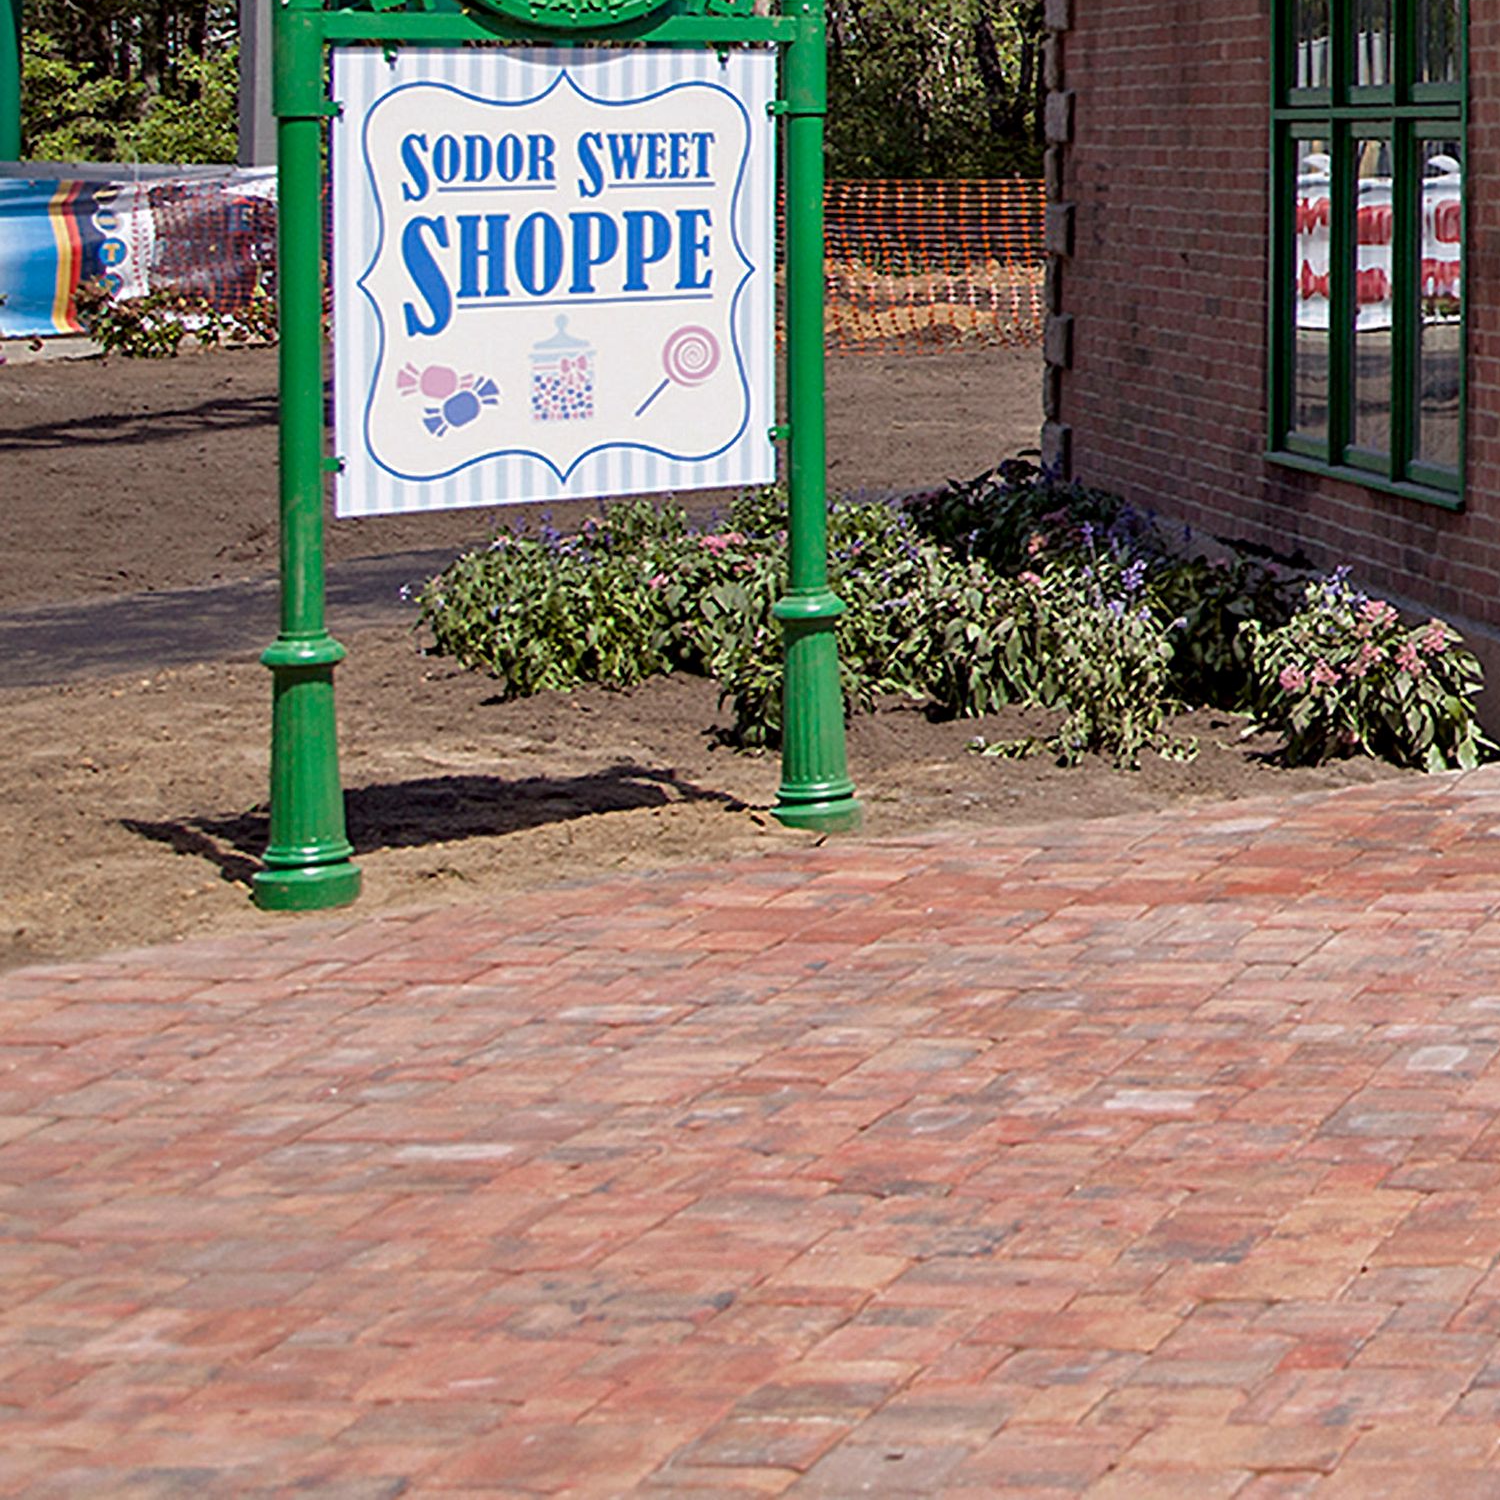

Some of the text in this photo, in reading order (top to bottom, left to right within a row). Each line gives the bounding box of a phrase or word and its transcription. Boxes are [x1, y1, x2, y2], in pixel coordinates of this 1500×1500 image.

[401, 131, 716, 202] SODOR SWEET
[401, 209, 714, 337] SHOPPE
